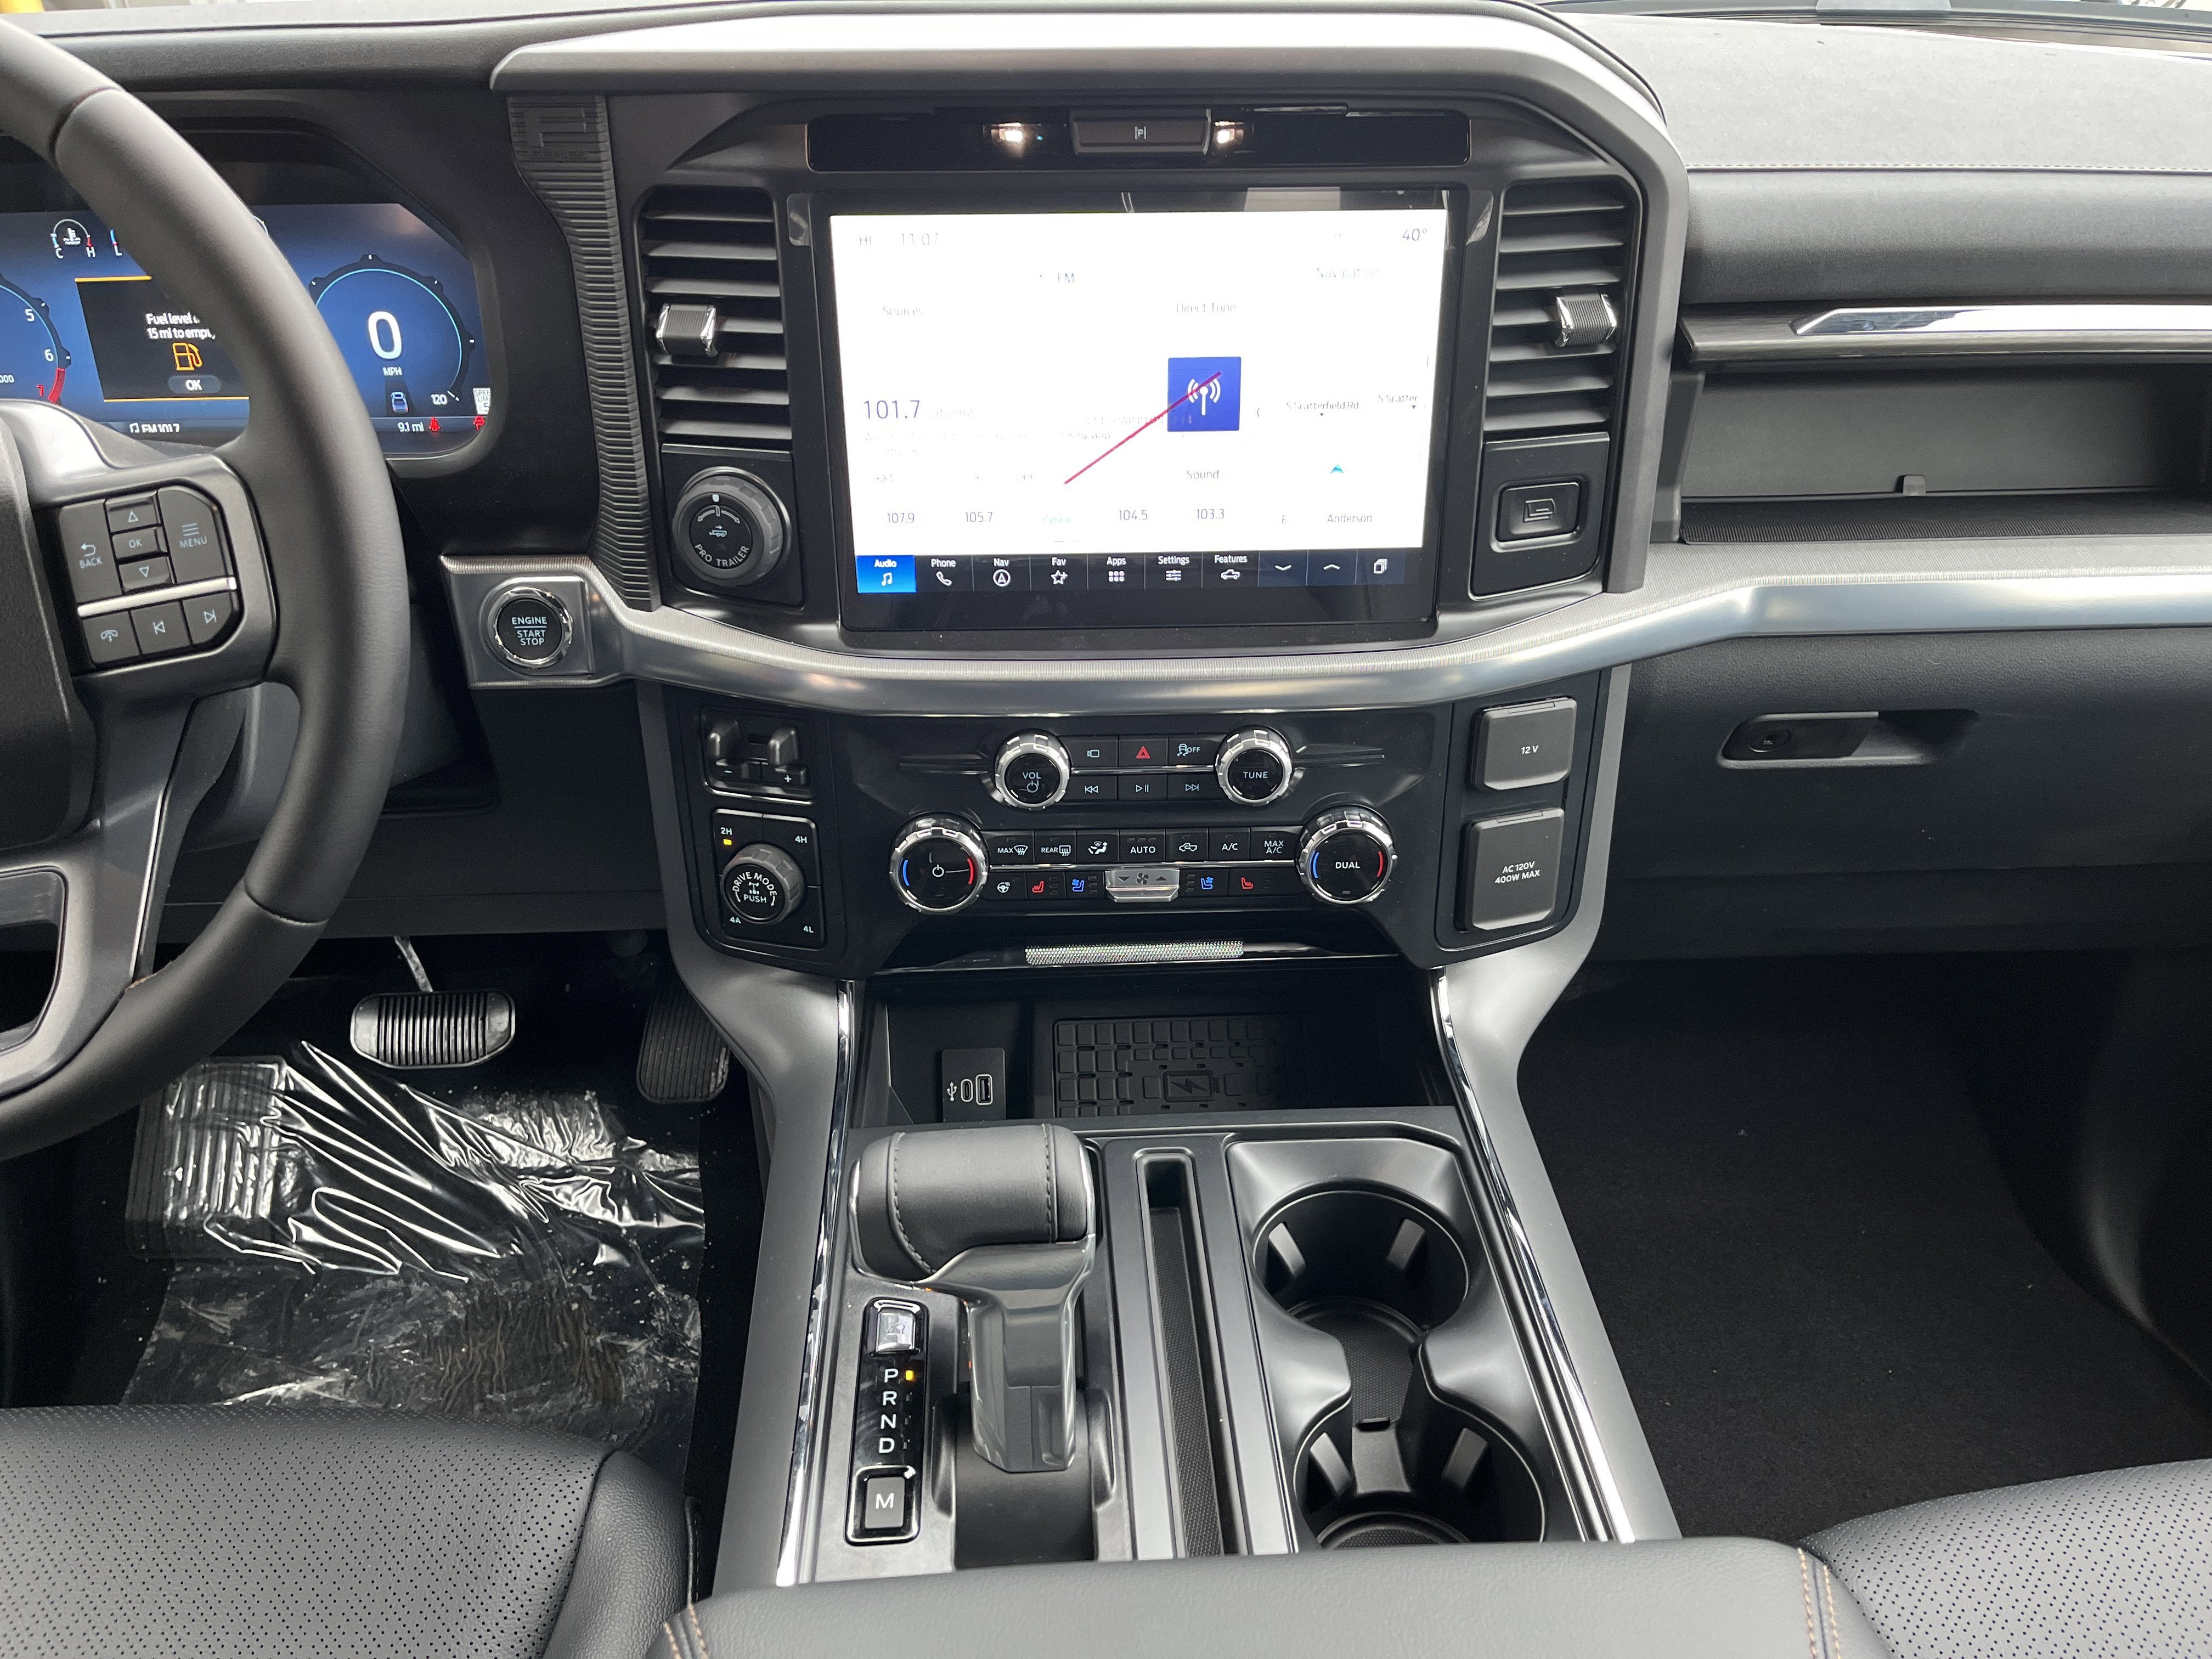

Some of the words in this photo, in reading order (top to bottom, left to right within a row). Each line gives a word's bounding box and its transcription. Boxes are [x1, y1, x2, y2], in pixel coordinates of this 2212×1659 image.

[55, 248, 64, 258] C
[86, 247, 95, 257] H
[114, 245, 122, 256] L
[25, 309, 35, 322] 5
[145, 312, 168, 325] Fuel
[168, 312, 193, 324] level
[146, 327, 159, 339] 15
[172, 328, 185, 338] to
[368, 311, 403, 360] 0
[44, 349, 54, 362] 6
[382, 366, 403, 376] MPH
[36, 385, 44, 397] 7
[185, 379, 202, 392] OK
[431, 393, 448, 405] 120
[864, 399, 921, 420] 101.7
[398, 422, 410, 432] 9.1
[411, 421, 425, 432] mi
[1186, 469, 1220, 479] Sound
[887, 512, 915, 524] 107.9
[964, 511, 993, 523] 105.7
[1119, 509, 1148, 521] 104.5
[1196, 508, 1225, 520] 103.3
[1327, 514, 1373, 523] Anderson
[128, 538, 143, 549] OK
[179, 535, 208, 549] MENU
[694, 543, 713, 563] PRO
[716, 545, 750, 567] TRAILER
[1157, 555, 1190, 566] Settings
[1214, 554, 1248, 564] Features
[79, 557, 103, 568] BACK
[874, 558, 898, 568] Audio
[930, 558, 956, 568] Phone
[994, 558, 1009, 567] Nav
[1052, 557, 1066, 566] Fav
[1106, 556, 1126, 567] Apps
[511, 617, 548, 625] ENGINE
[516, 630, 546, 638] START
[520, 637, 545, 646] STOP
[1521, 746, 1531, 754] 12
[1531, 745, 1539, 753] V
[1022, 771, 1041, 780] VOL
[1243, 771, 1268, 780] TUNE
[720, 826, 733, 836] 2H
[794, 835, 808, 844] 4H
[1263, 839, 1284, 848] MAX
[1130, 845, 1156, 854] AUTO
[1221, 842, 1238, 851] A/C
[1265, 846, 1283, 855] A/C
[1335, 861, 1361, 870] DUAL
[1502, 864, 1514, 874] AC
[1515, 861, 1536, 871] 120V
[1494, 874, 1520, 885] 400W
[1521, 870, 1541, 880] MAX
[732, 871, 753, 893] DRIVE
[753, 872, 778, 897] MODE
[743, 893, 768, 904] PUSH
[730, 916, 742, 924] 4A
[884, 1368, 899, 1383] P
[882, 1391, 898, 1406] R
[881, 1414, 897, 1429] N
[878, 1437, 895, 1454] D
[875, 1493, 894, 1509] M
